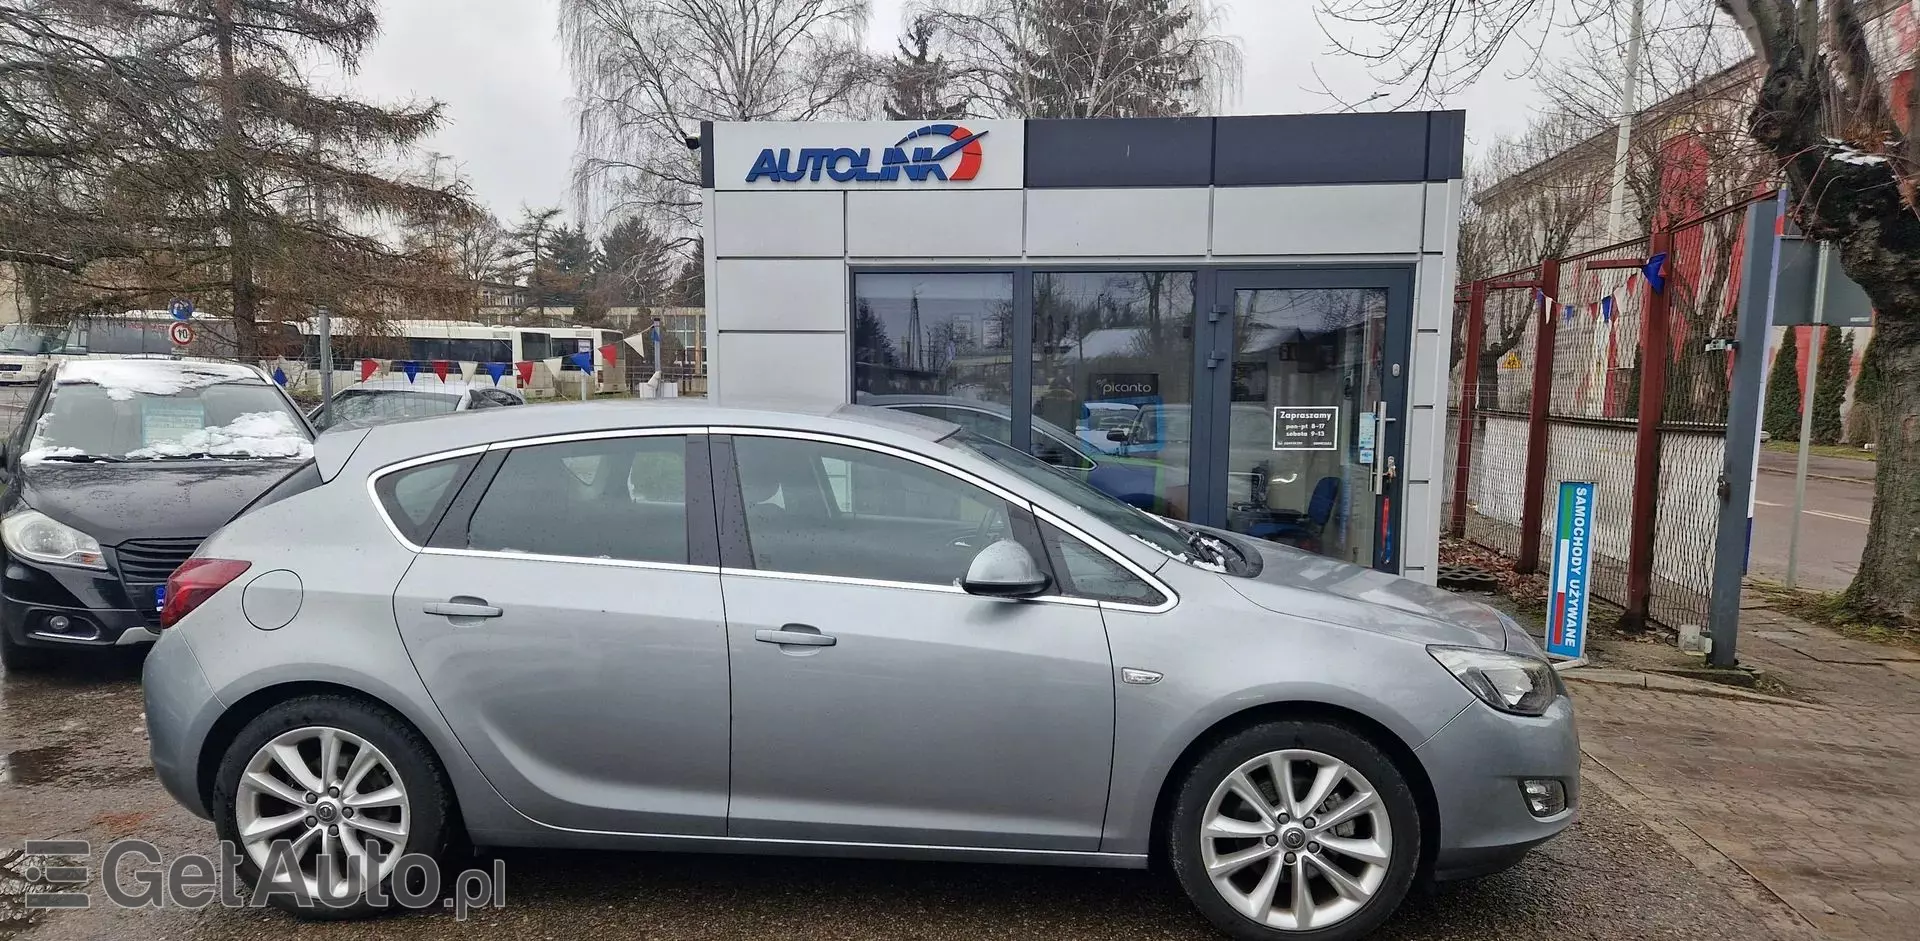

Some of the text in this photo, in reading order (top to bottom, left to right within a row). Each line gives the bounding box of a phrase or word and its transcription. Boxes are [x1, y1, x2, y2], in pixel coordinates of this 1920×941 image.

[745, 142, 962, 182] AUTOLINK
[1102, 382, 1152, 396] picanto
[1280, 411, 1332, 421] Zapraszamy
[1564, 487, 1587, 648] SAMOCHODY UŻYWANE
